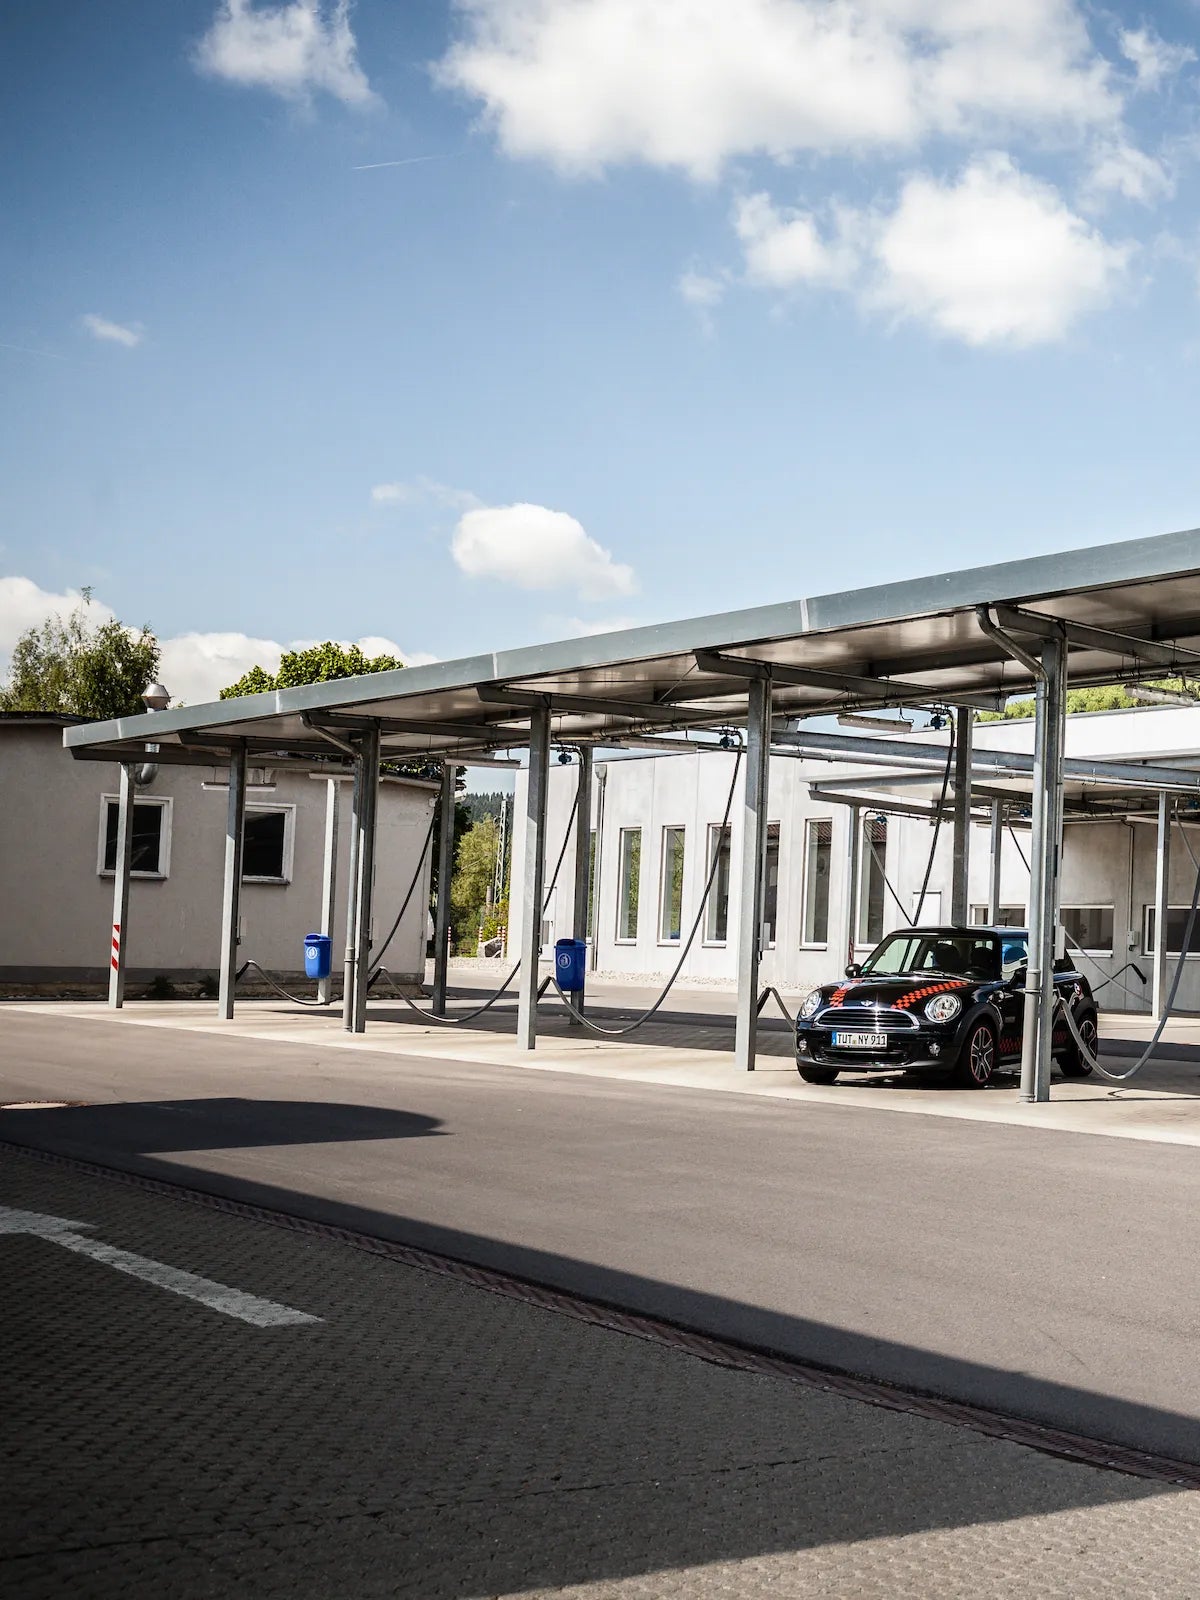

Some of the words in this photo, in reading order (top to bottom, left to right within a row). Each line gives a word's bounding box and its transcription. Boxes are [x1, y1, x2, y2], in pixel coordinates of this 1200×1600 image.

[837, 1033, 853, 1044] TUT
[858, 1034, 869, 1045] NY
[871, 1035, 886, 1045] 911
